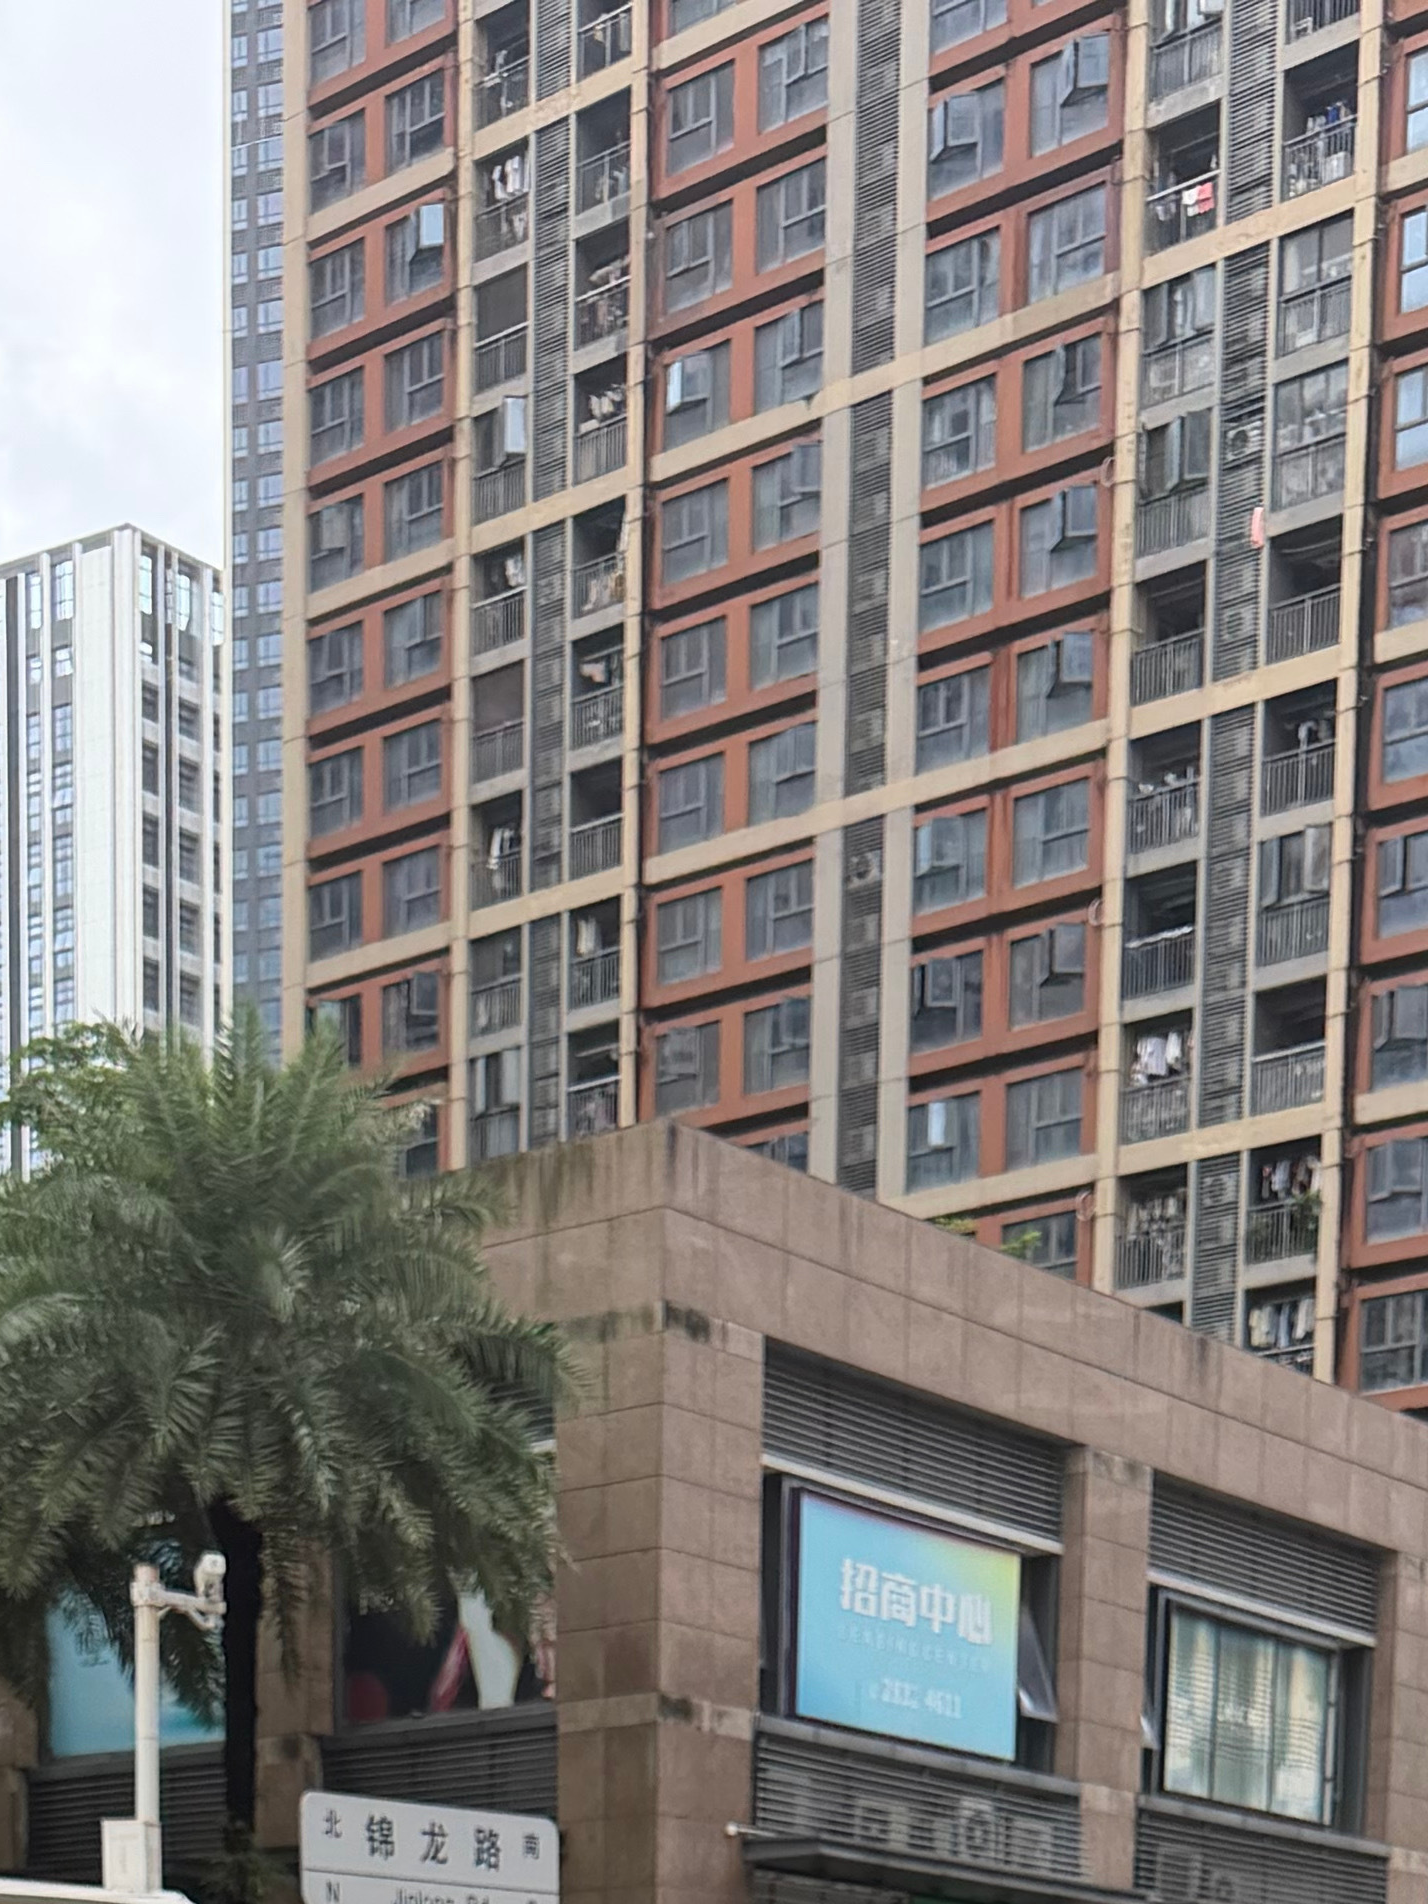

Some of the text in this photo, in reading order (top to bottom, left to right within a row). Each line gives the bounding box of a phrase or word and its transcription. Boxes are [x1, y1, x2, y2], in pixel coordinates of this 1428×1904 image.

[839, 1557, 994, 1646] 招商中心
[324, 1808, 541, 1873] 北 锦龙路 南
[325, 1880, 341, 1904] N
